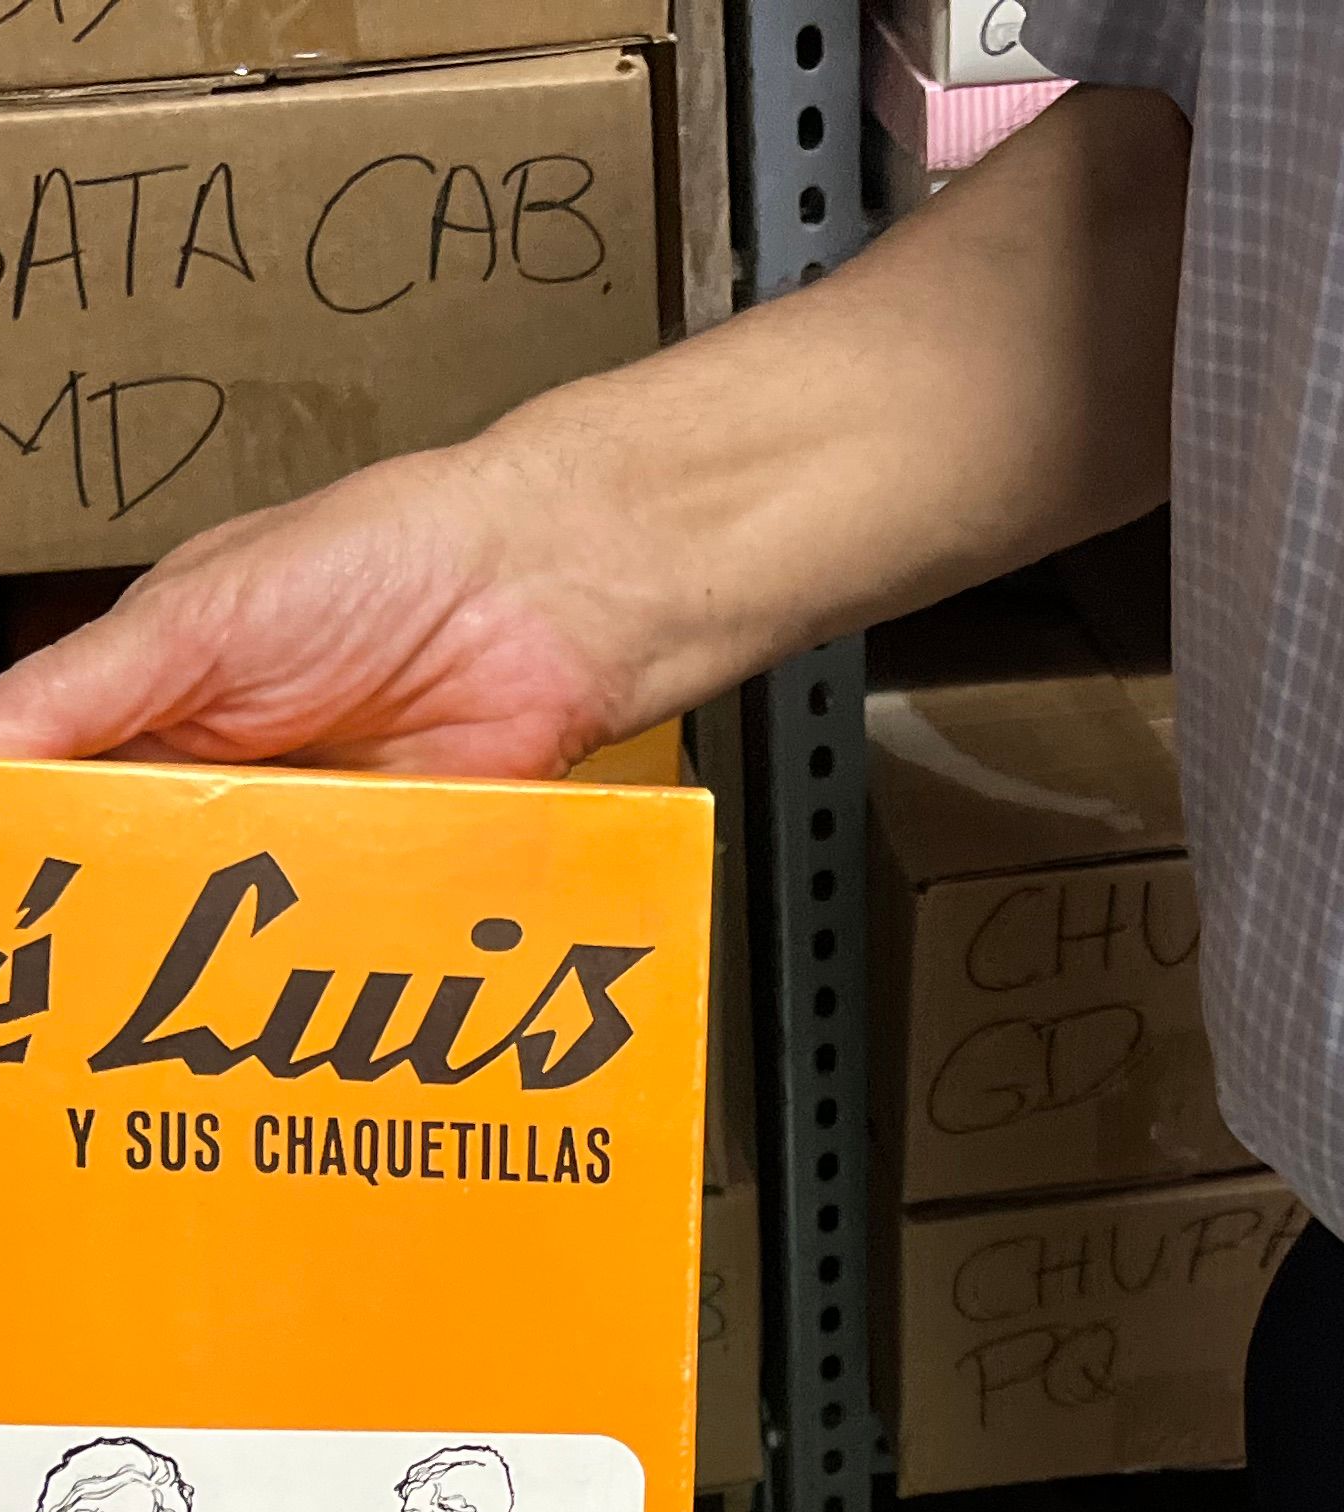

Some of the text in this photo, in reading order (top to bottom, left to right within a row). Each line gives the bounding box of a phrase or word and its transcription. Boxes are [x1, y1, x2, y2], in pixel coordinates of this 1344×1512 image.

[305, 154, 613, 314] CAB.
[88, 852, 656, 1090] Luis
[926, 1003, 1144, 1136] GD
[67, 1107, 610, 1186] Y SUS CHAQUETILLAS
[955, 1318, 1123, 1431] PQ
